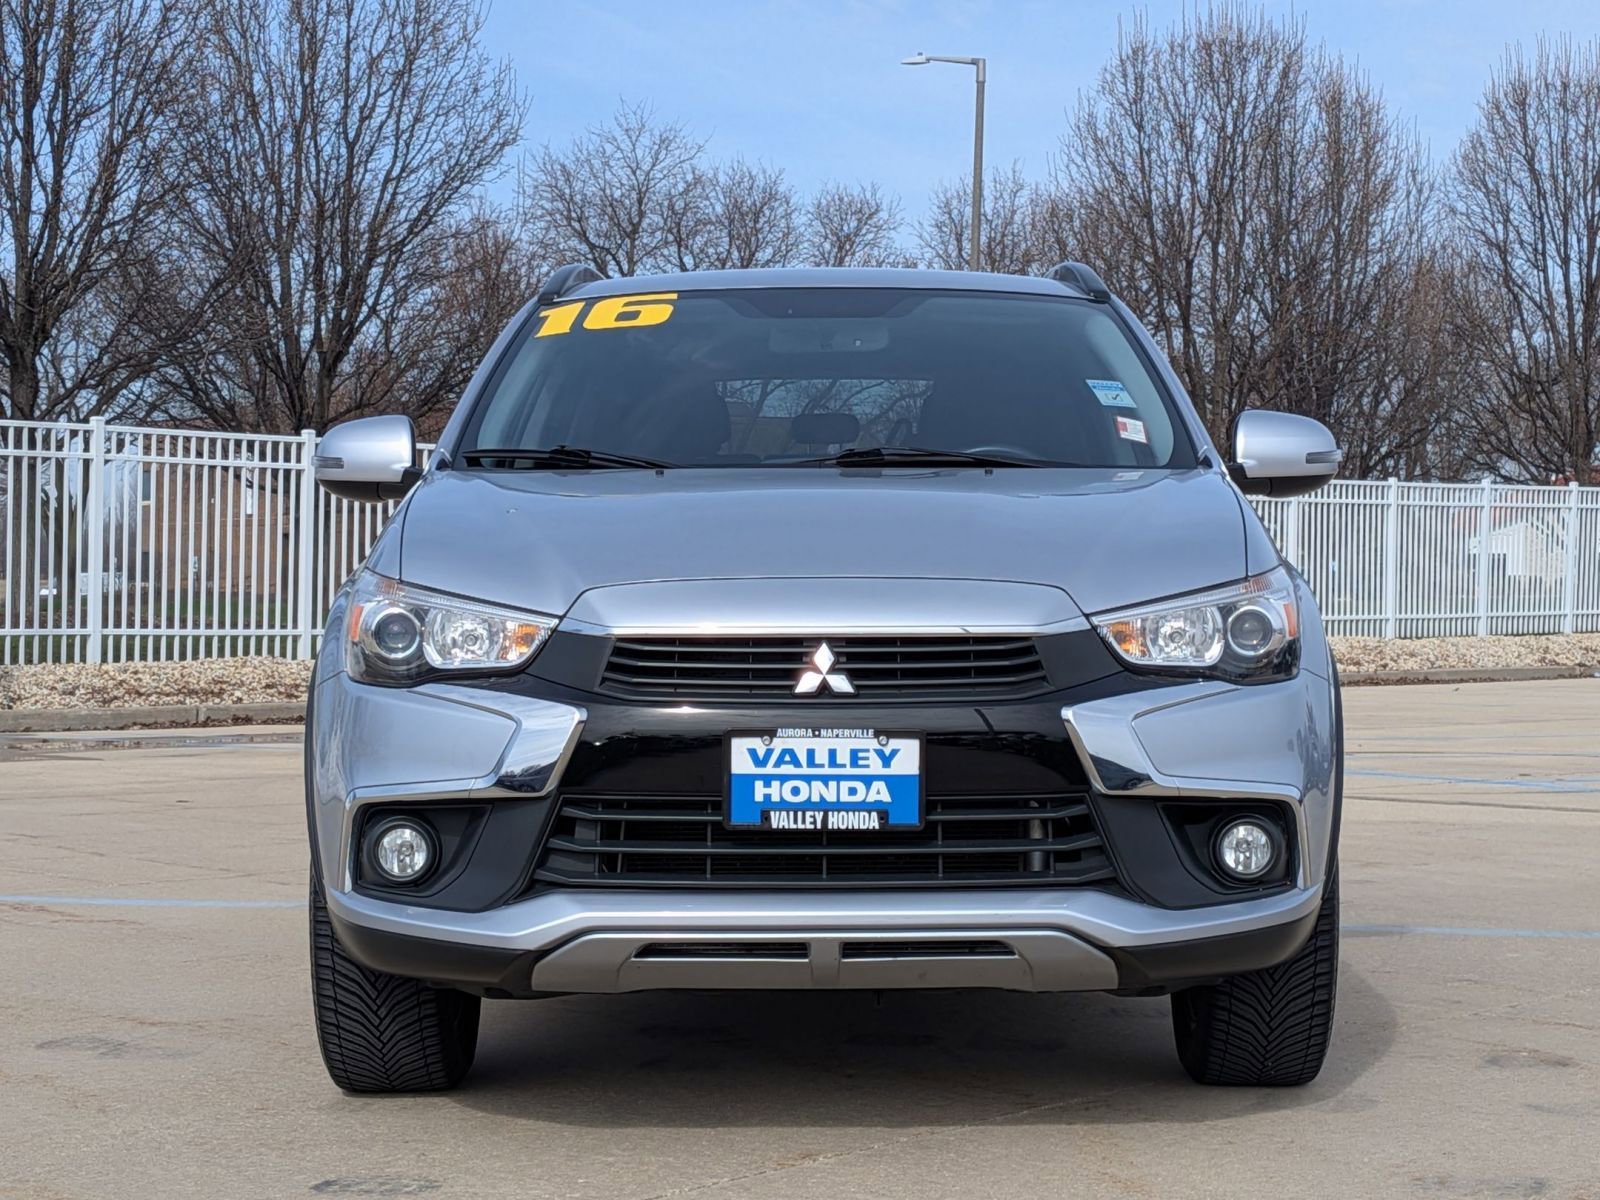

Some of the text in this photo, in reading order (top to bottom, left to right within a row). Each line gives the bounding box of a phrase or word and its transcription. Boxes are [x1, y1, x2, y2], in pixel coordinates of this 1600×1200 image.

[534, 293, 678, 338] 16
[776, 728, 874, 738] AURORA NAPERVILLE
[746, 748, 901, 769] VALLEY
[754, 780, 892, 802] HONDA
[770, 811, 880, 830] VALLEY HONDA
